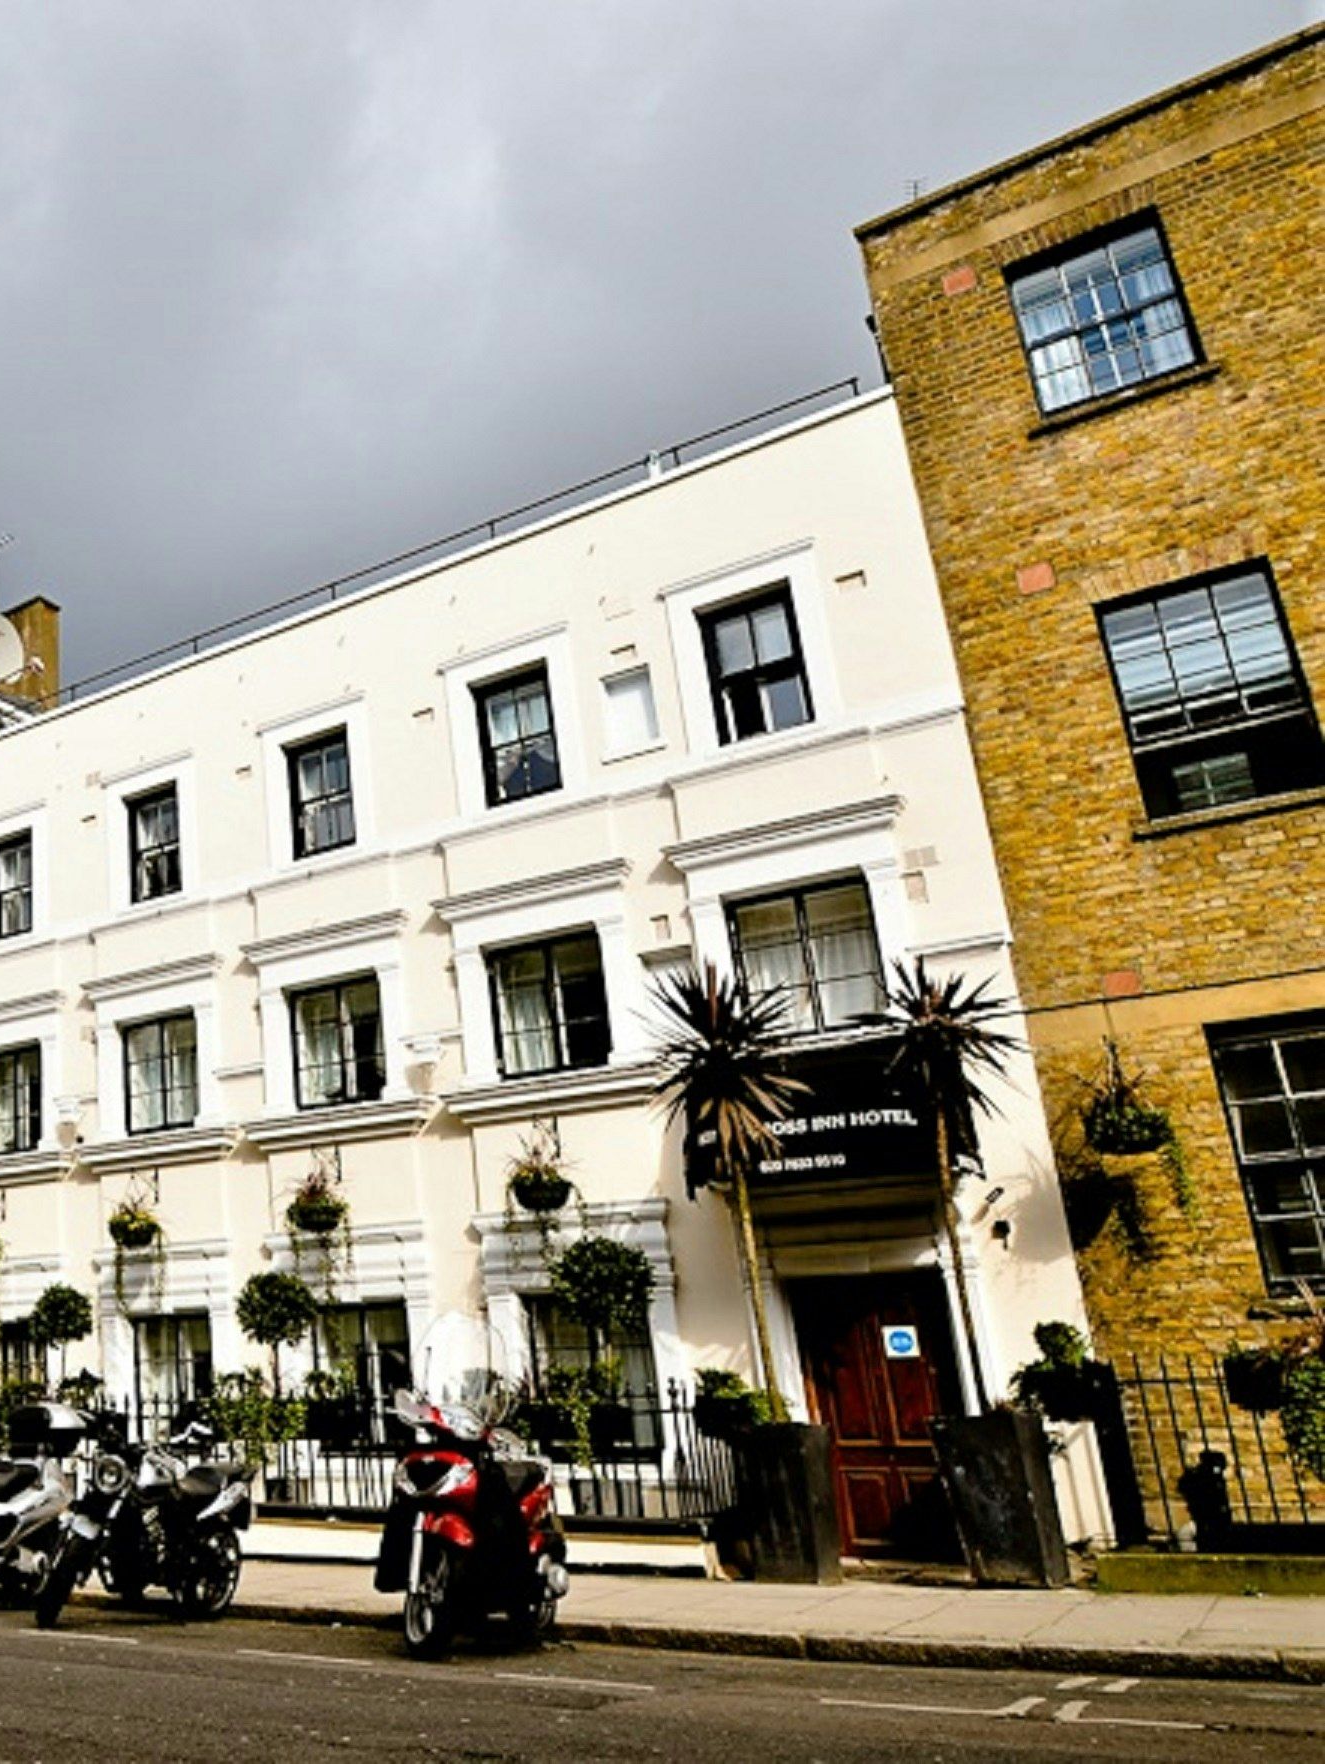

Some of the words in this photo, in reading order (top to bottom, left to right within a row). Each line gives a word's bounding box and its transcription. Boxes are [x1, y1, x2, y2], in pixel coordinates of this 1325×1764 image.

[763, 1118, 807, 1135] OSS
[811, 1114, 845, 1132] INN
[849, 1109, 918, 1127] HOTEL
